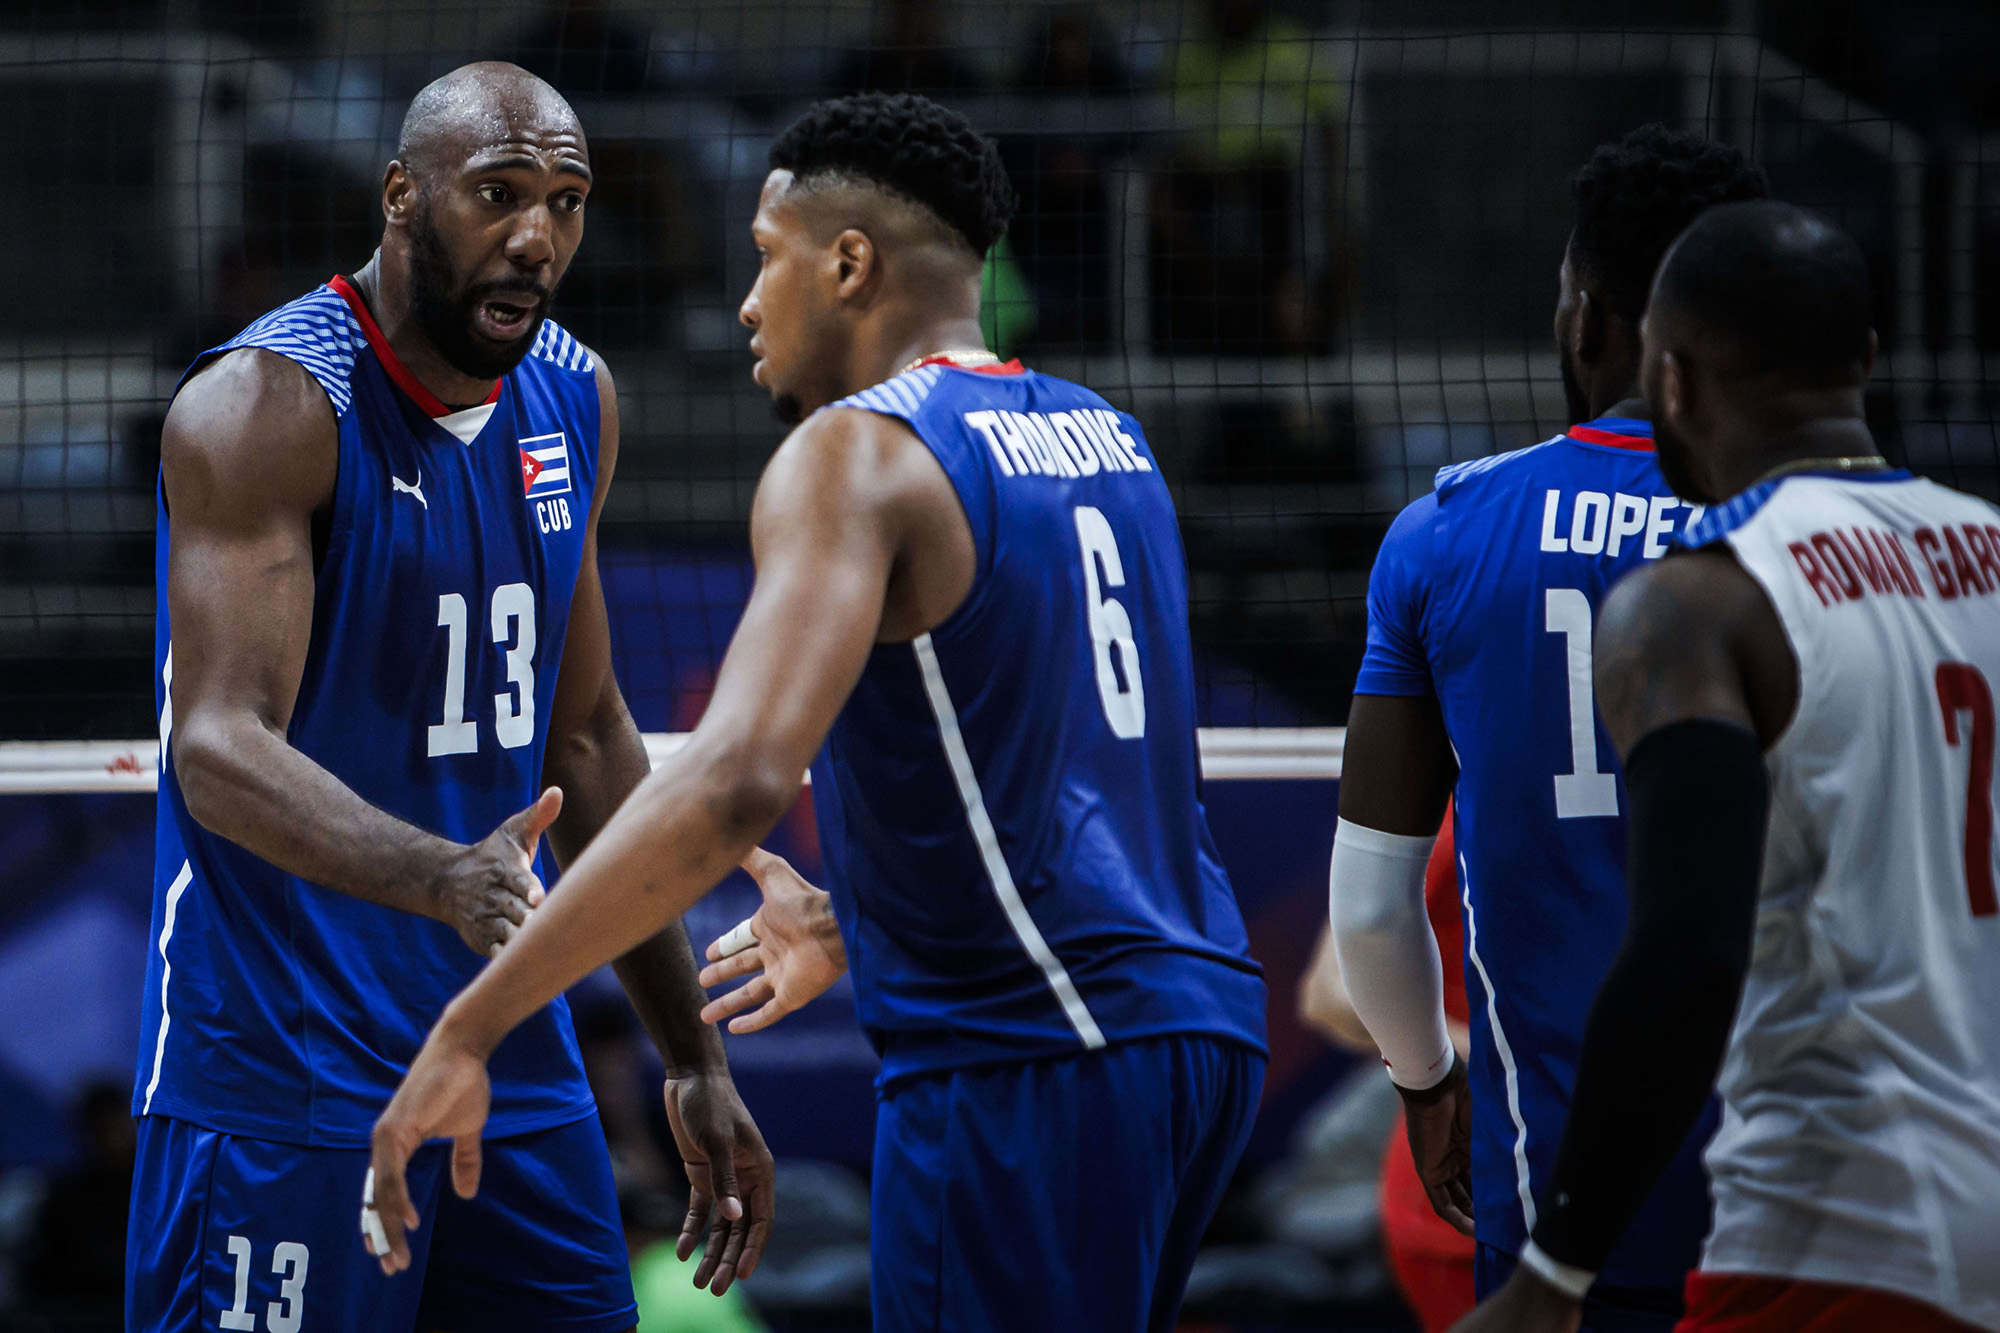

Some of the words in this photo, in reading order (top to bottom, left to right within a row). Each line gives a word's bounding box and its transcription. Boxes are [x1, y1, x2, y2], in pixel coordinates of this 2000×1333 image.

[536, 497, 572, 534] CUB
[1787, 526, 1926, 609] ROMAN
[427, 582, 536, 758] 13
[1073, 505, 1147, 739] 6
[1935, 661, 1999, 919] 7
[219, 1235, 310, 1333] 13
